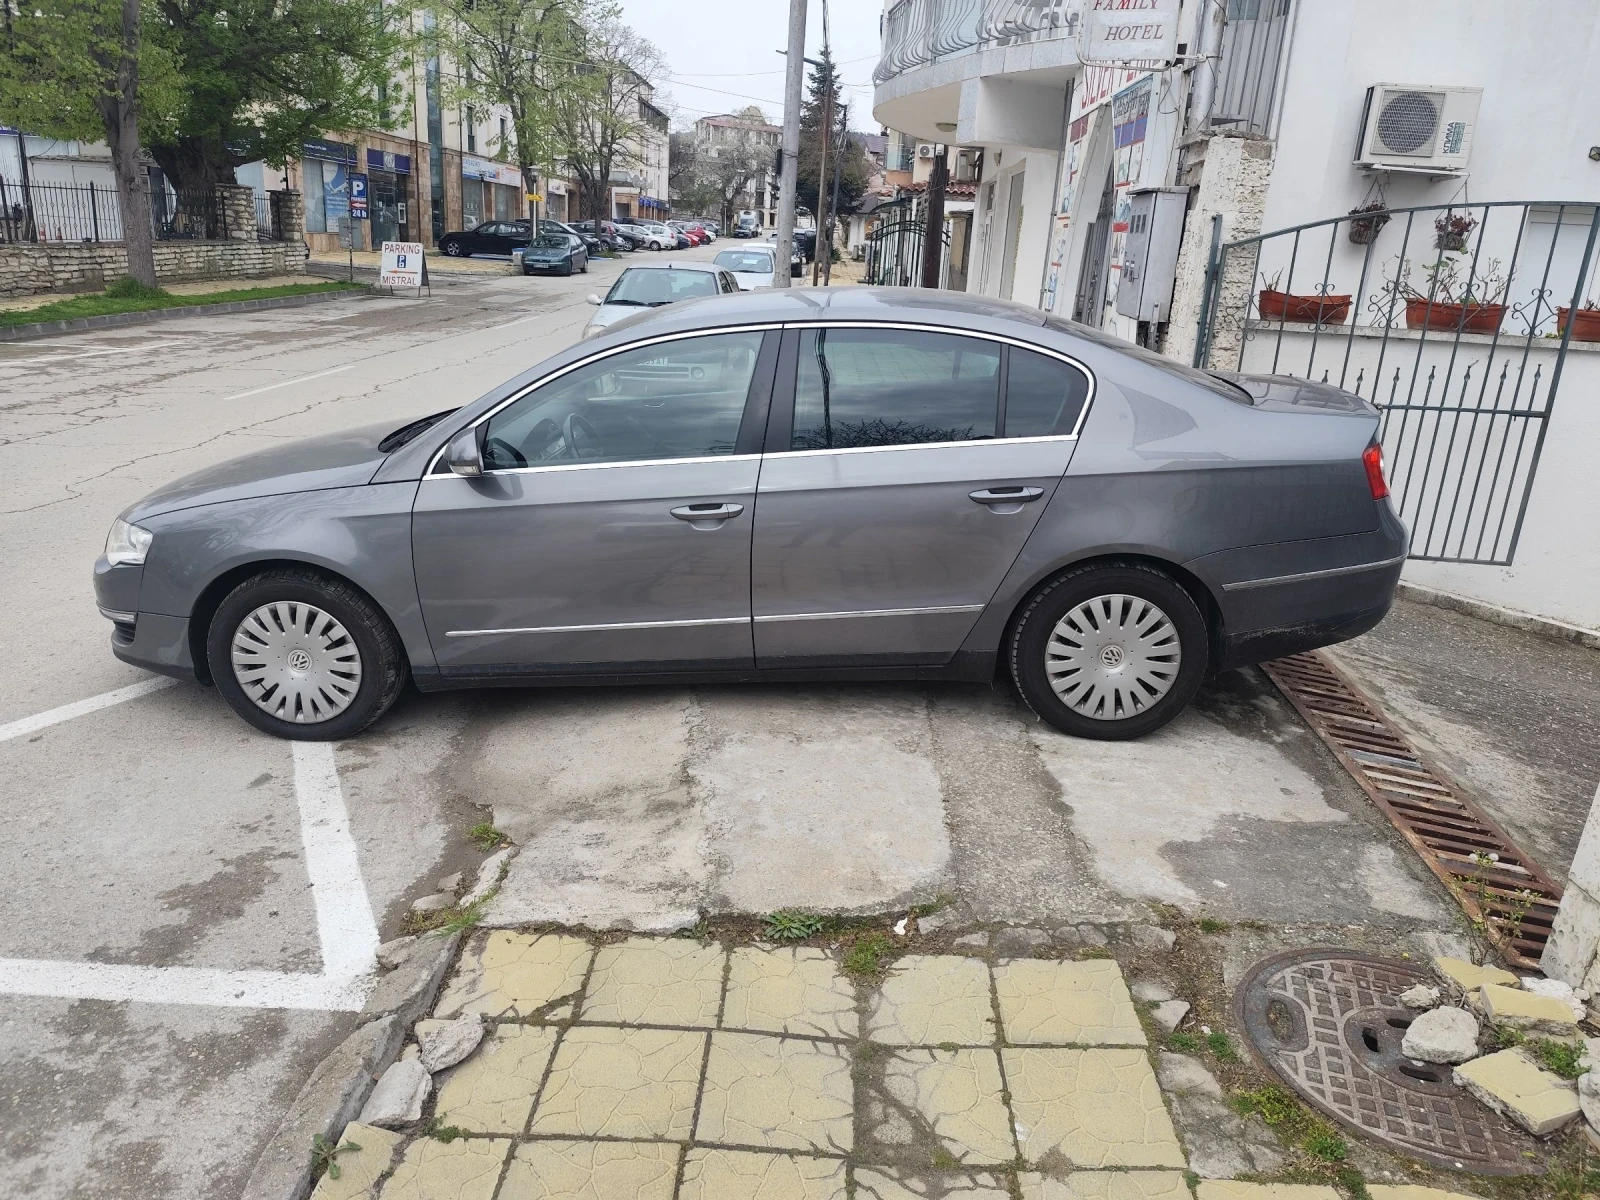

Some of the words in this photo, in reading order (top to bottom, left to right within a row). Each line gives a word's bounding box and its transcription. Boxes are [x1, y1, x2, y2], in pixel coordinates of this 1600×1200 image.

[1093, 0, 1158, 10] FAMILY
[1104, 25, 1163, 40] HOTEL
[1442, 122, 1454, 153] КЛИМА
[352, 209, 361, 217] 24
[384, 243, 420, 254] PARKING
[382, 276, 417, 285] MISTRAL
